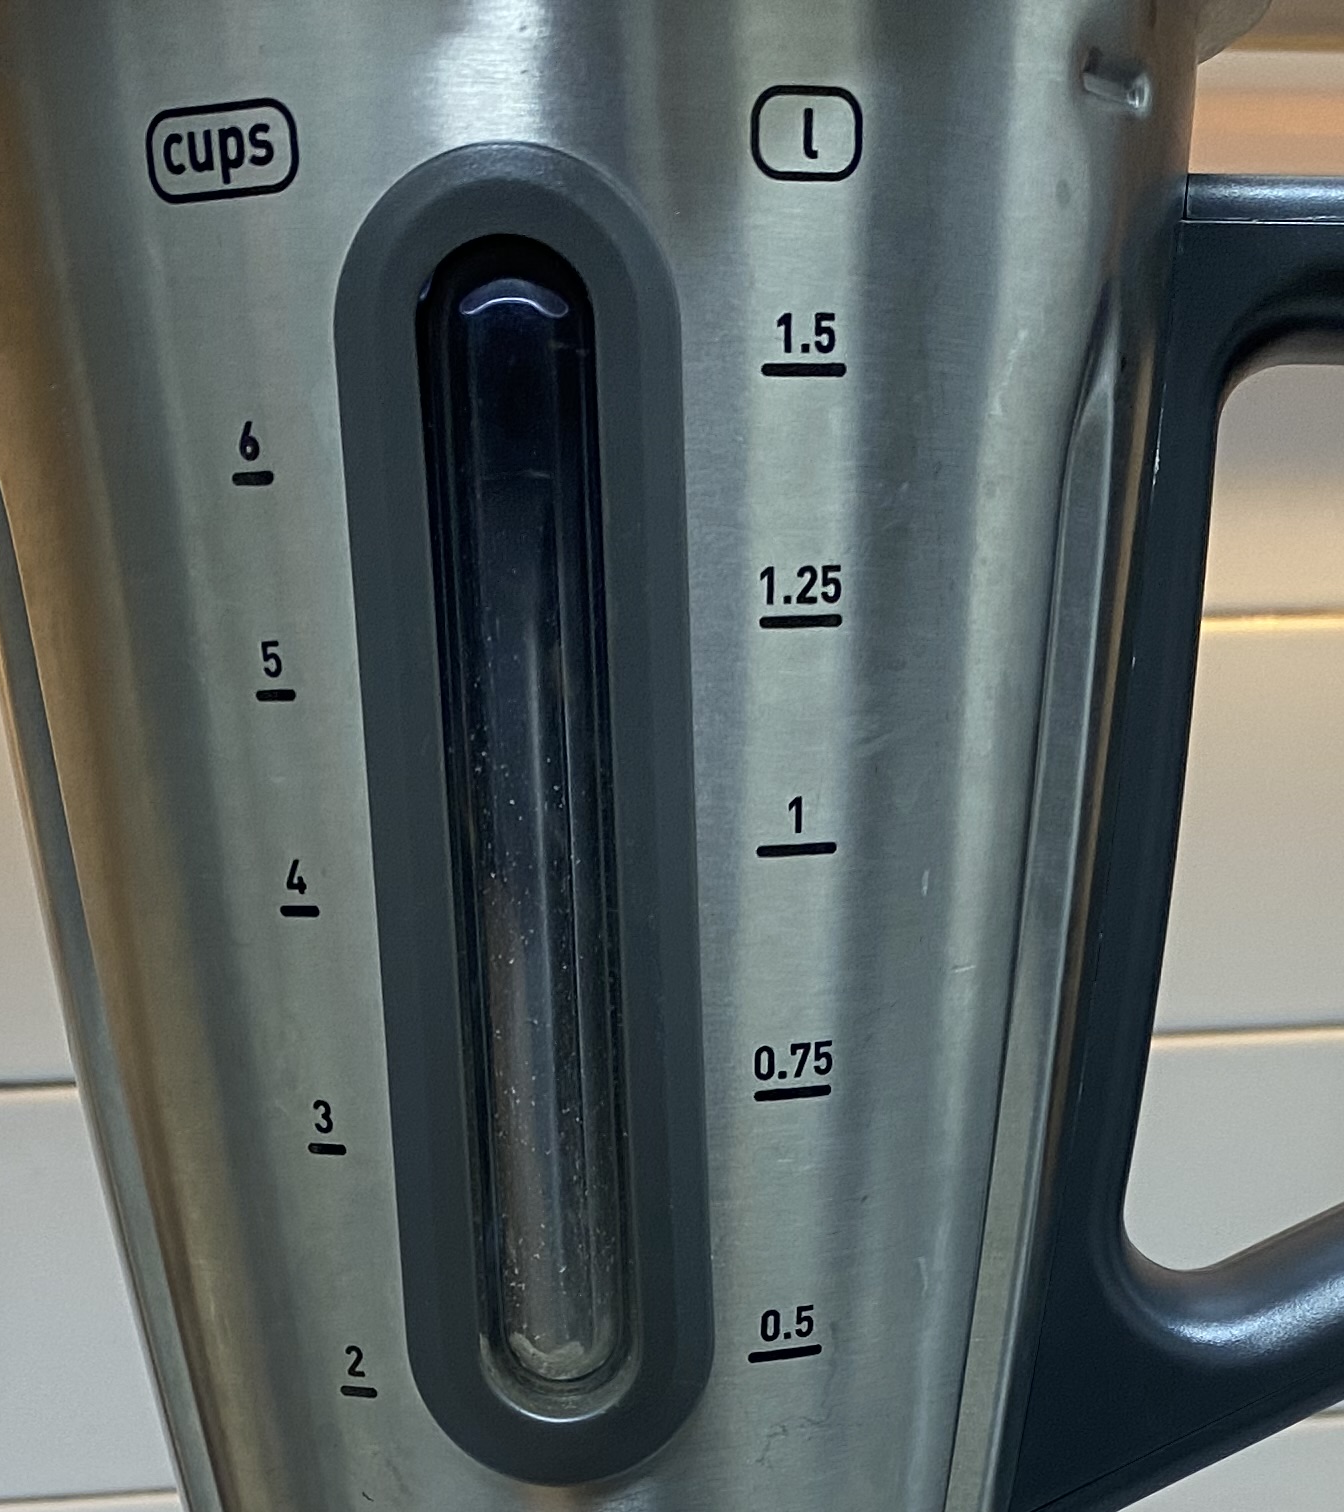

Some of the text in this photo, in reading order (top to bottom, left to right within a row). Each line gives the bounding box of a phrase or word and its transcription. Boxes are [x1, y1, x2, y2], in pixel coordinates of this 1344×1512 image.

[163, 126, 275, 185] cups
[776, 311, 837, 355] 1.5
[238, 420, 261, 463] 6
[759, 564, 843, 607] 1.25
[261, 640, 284, 679] 5
[787, 795, 804, 834] 1
[285, 858, 308, 896] 4
[754, 1040, 834, 1082] 0.75
[312, 1099, 335, 1135] 3
[759, 1304, 815, 1342] 0.5
[344, 1344, 366, 1378] 2
